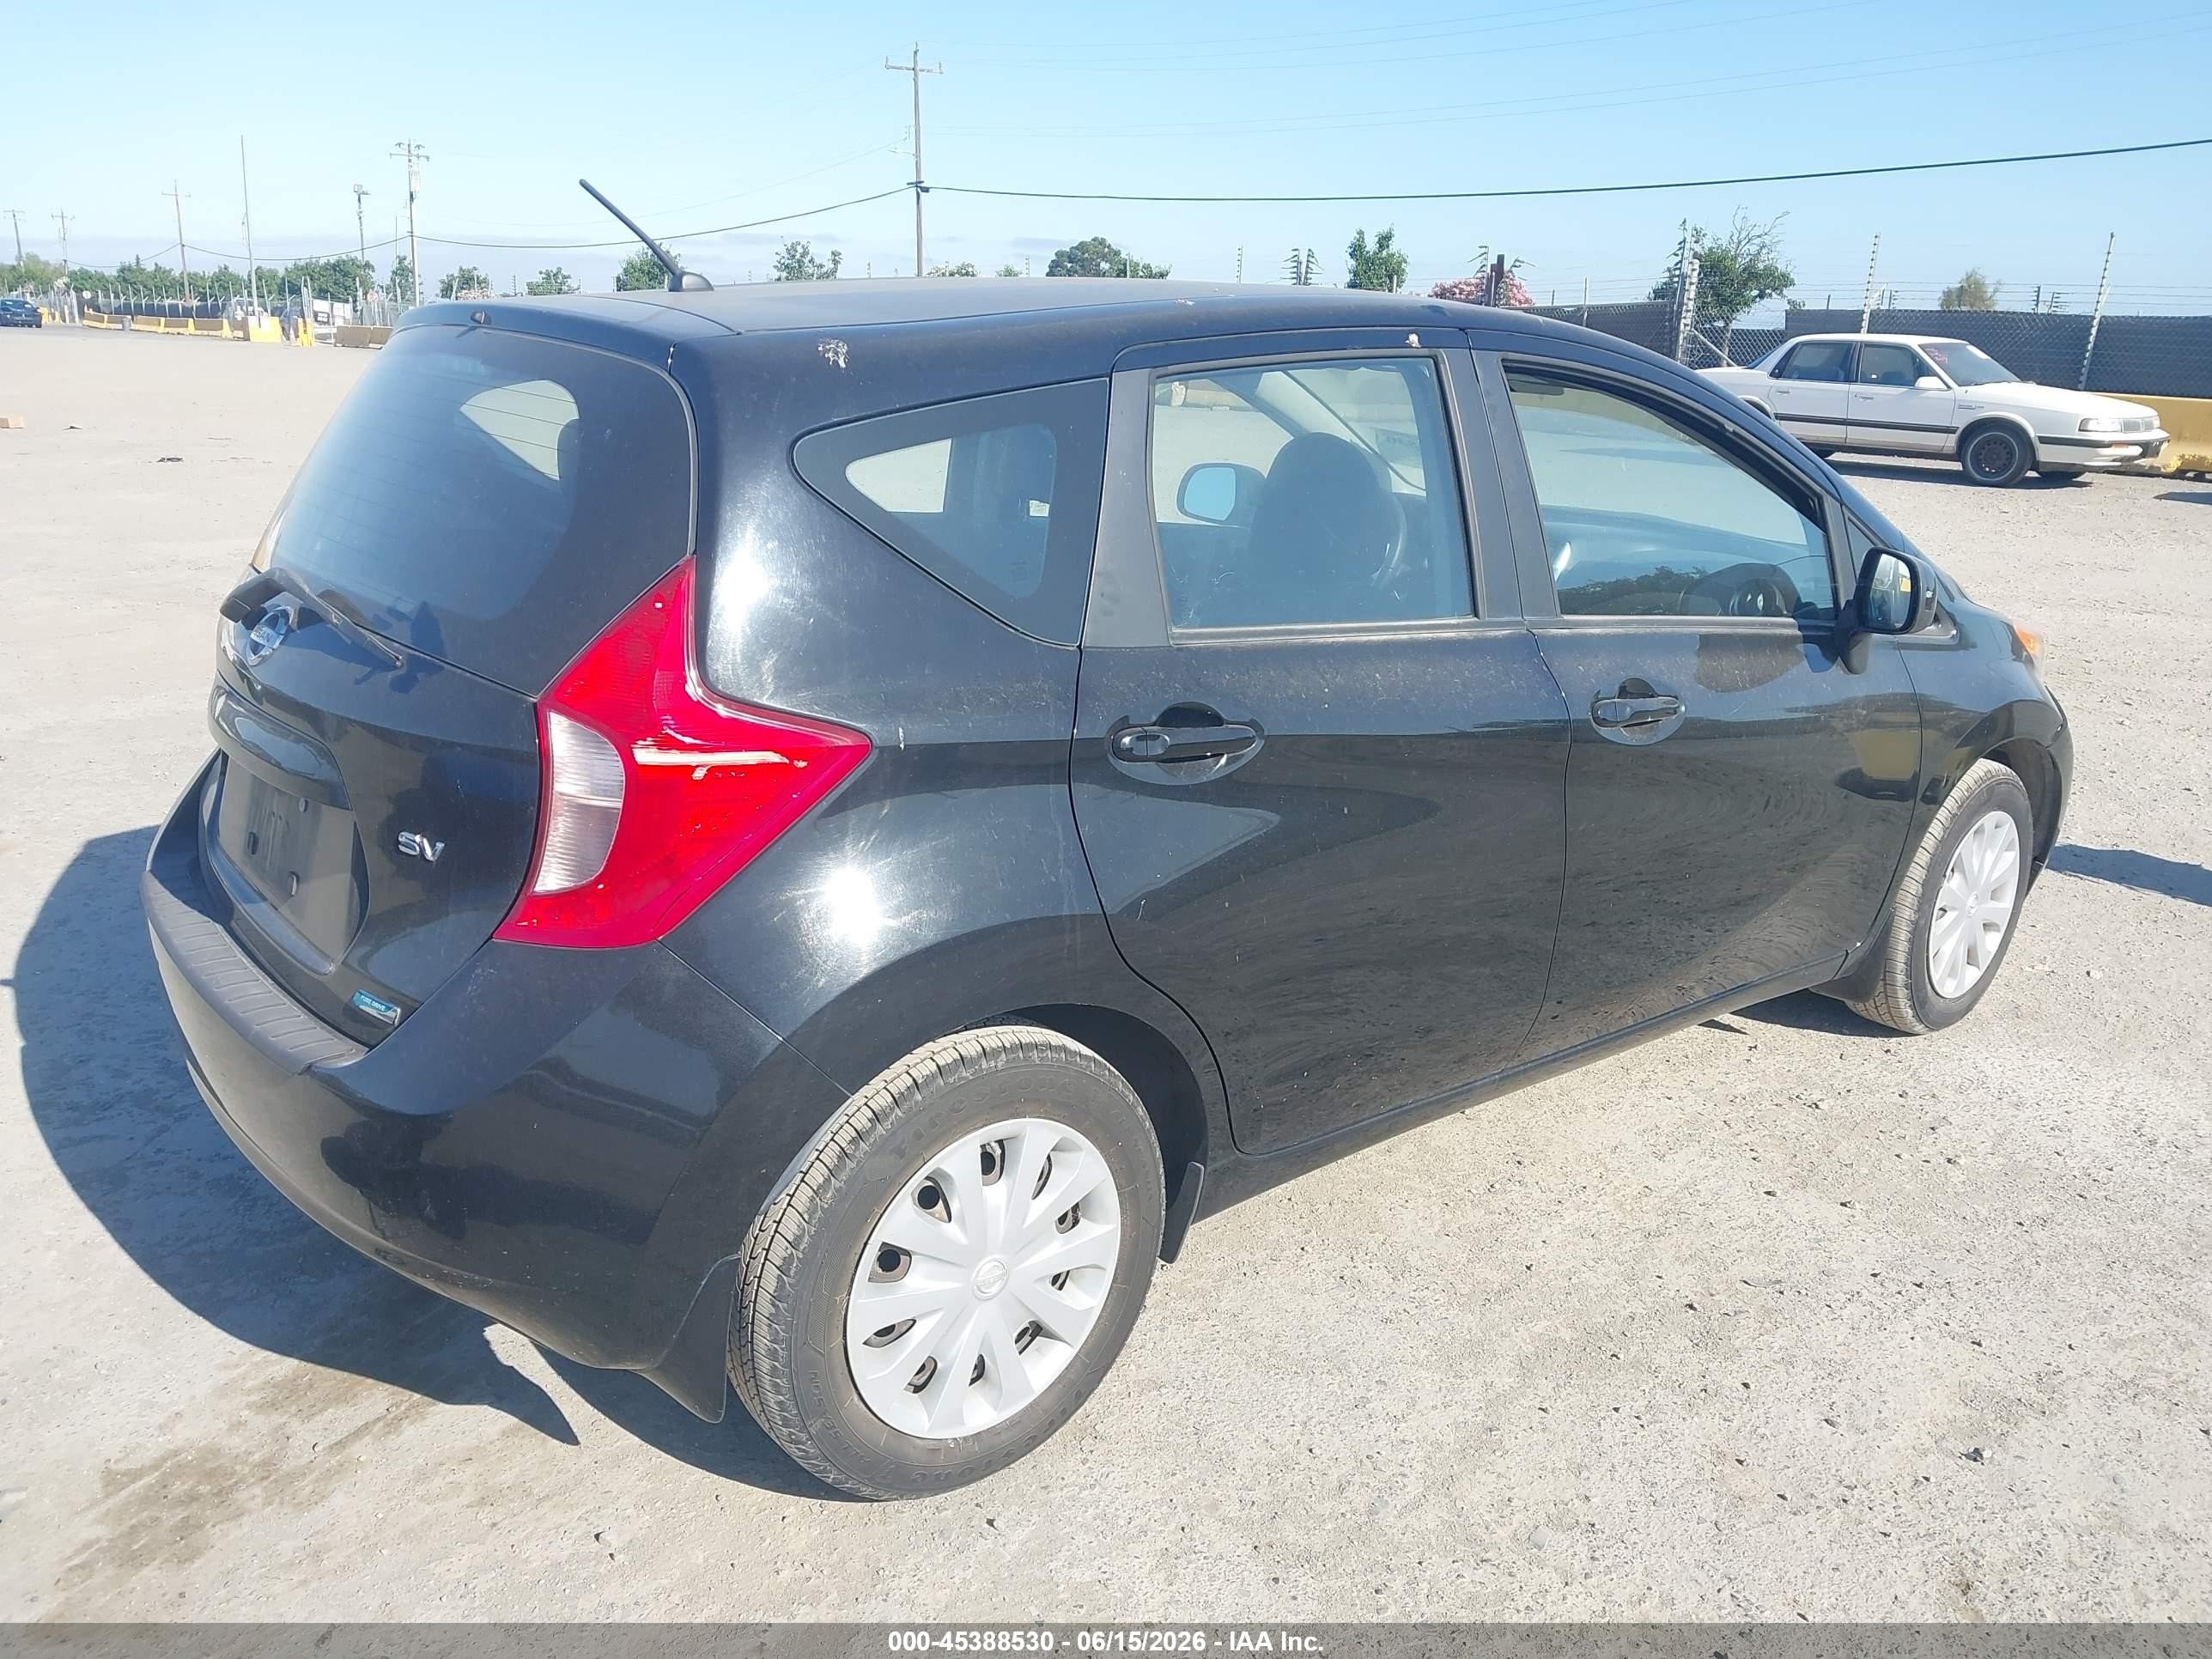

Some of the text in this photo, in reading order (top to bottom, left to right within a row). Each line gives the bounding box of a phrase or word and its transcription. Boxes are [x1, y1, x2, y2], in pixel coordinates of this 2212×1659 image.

[398, 831, 445, 861] SV
[806, 1365, 846, 1444] SEASON
[838, 1437, 874, 1471] ALL
